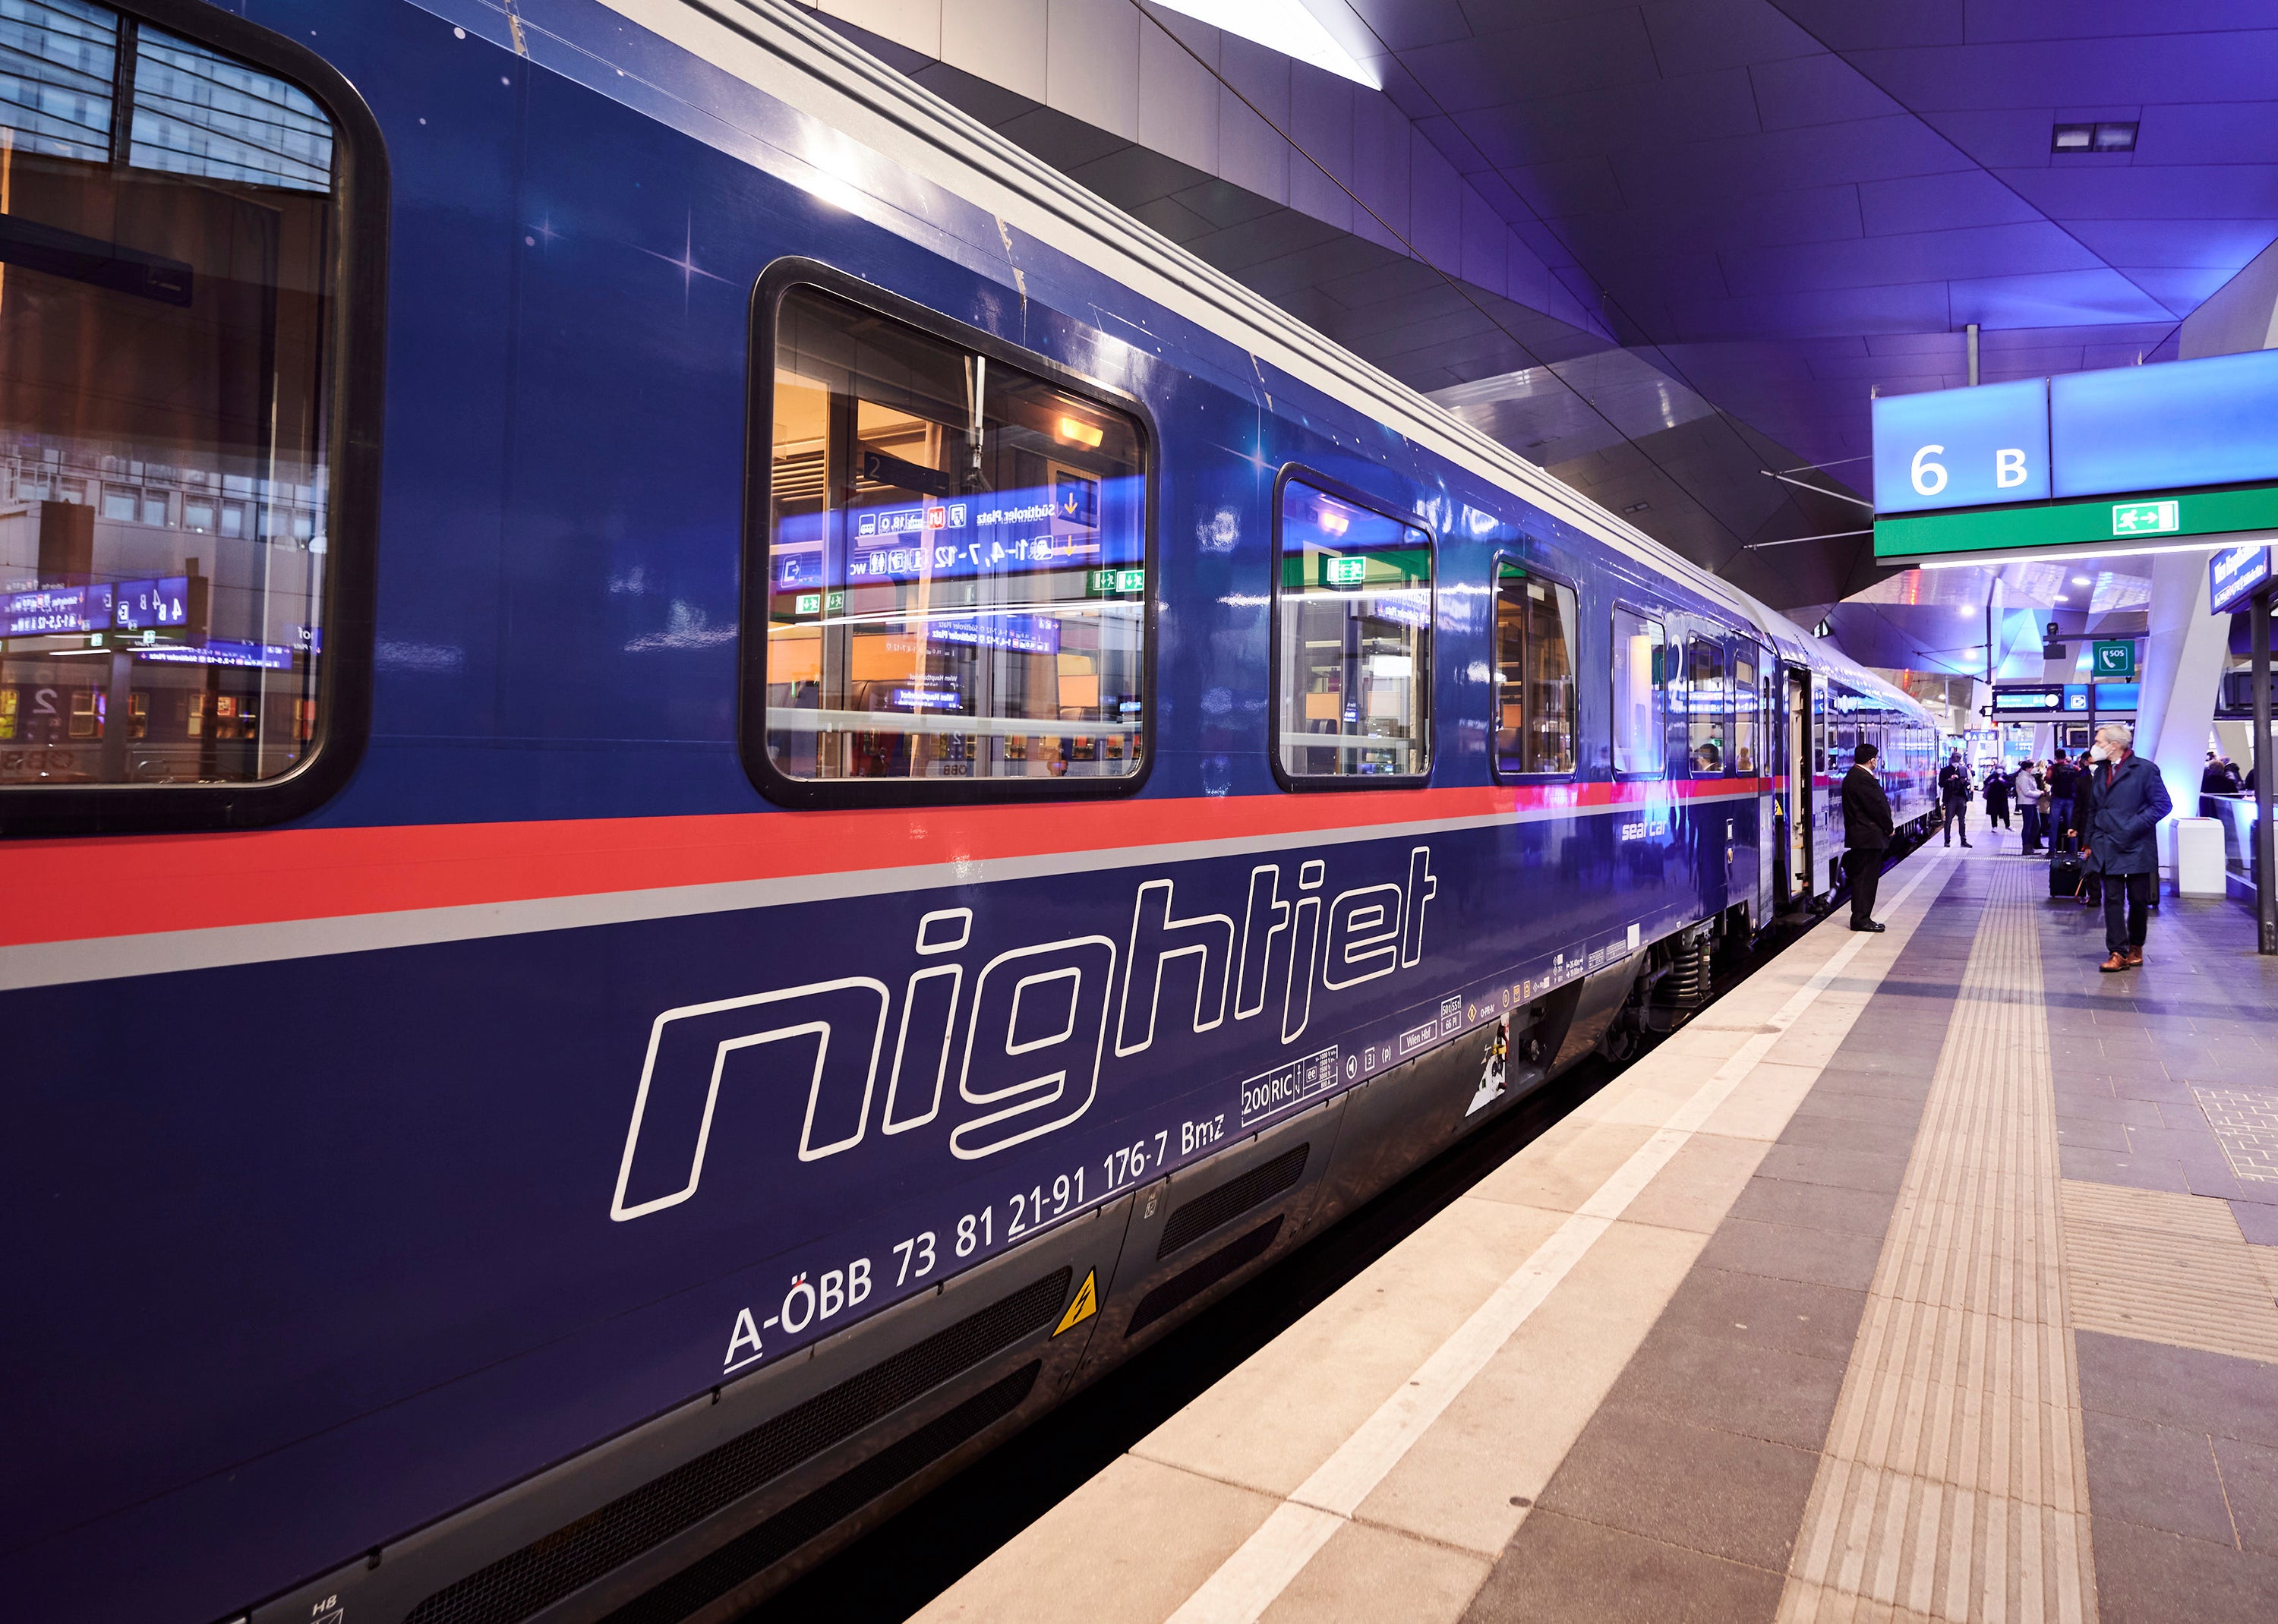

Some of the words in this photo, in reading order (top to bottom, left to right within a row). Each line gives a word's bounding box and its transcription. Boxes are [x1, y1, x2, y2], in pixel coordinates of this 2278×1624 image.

[869, 456, 880, 478] 2
[1910, 445, 1948, 496] 6
[1996, 449, 2028, 489] B
[1622, 818, 1646, 840] seat
[1649, 820, 1667, 837] car
[611, 847, 1437, 1222] nightjet
[1406, 1033, 1420, 1048] Wien
[1421, 1027, 1431, 1043] Hbf
[1368, 1054, 1372, 1064] 3
[1382, 1045, 1391, 1064] (p)
[1308, 1069, 1316, 1080] ee
[1243, 1083, 1270, 1115] 200
[1271, 1074, 1292, 1103] RIC
[724, 1257, 872, 1369] A-ÖBB
[893, 1231, 936, 1287] 73
[956, 1206, 992, 1257] 81
[1008, 1166, 1086, 1239] 21-91
[1103, 1131, 1168, 1190] 176-7
[1181, 1113, 1225, 1156] Bmz
[312, 1594, 337, 1616] HB
